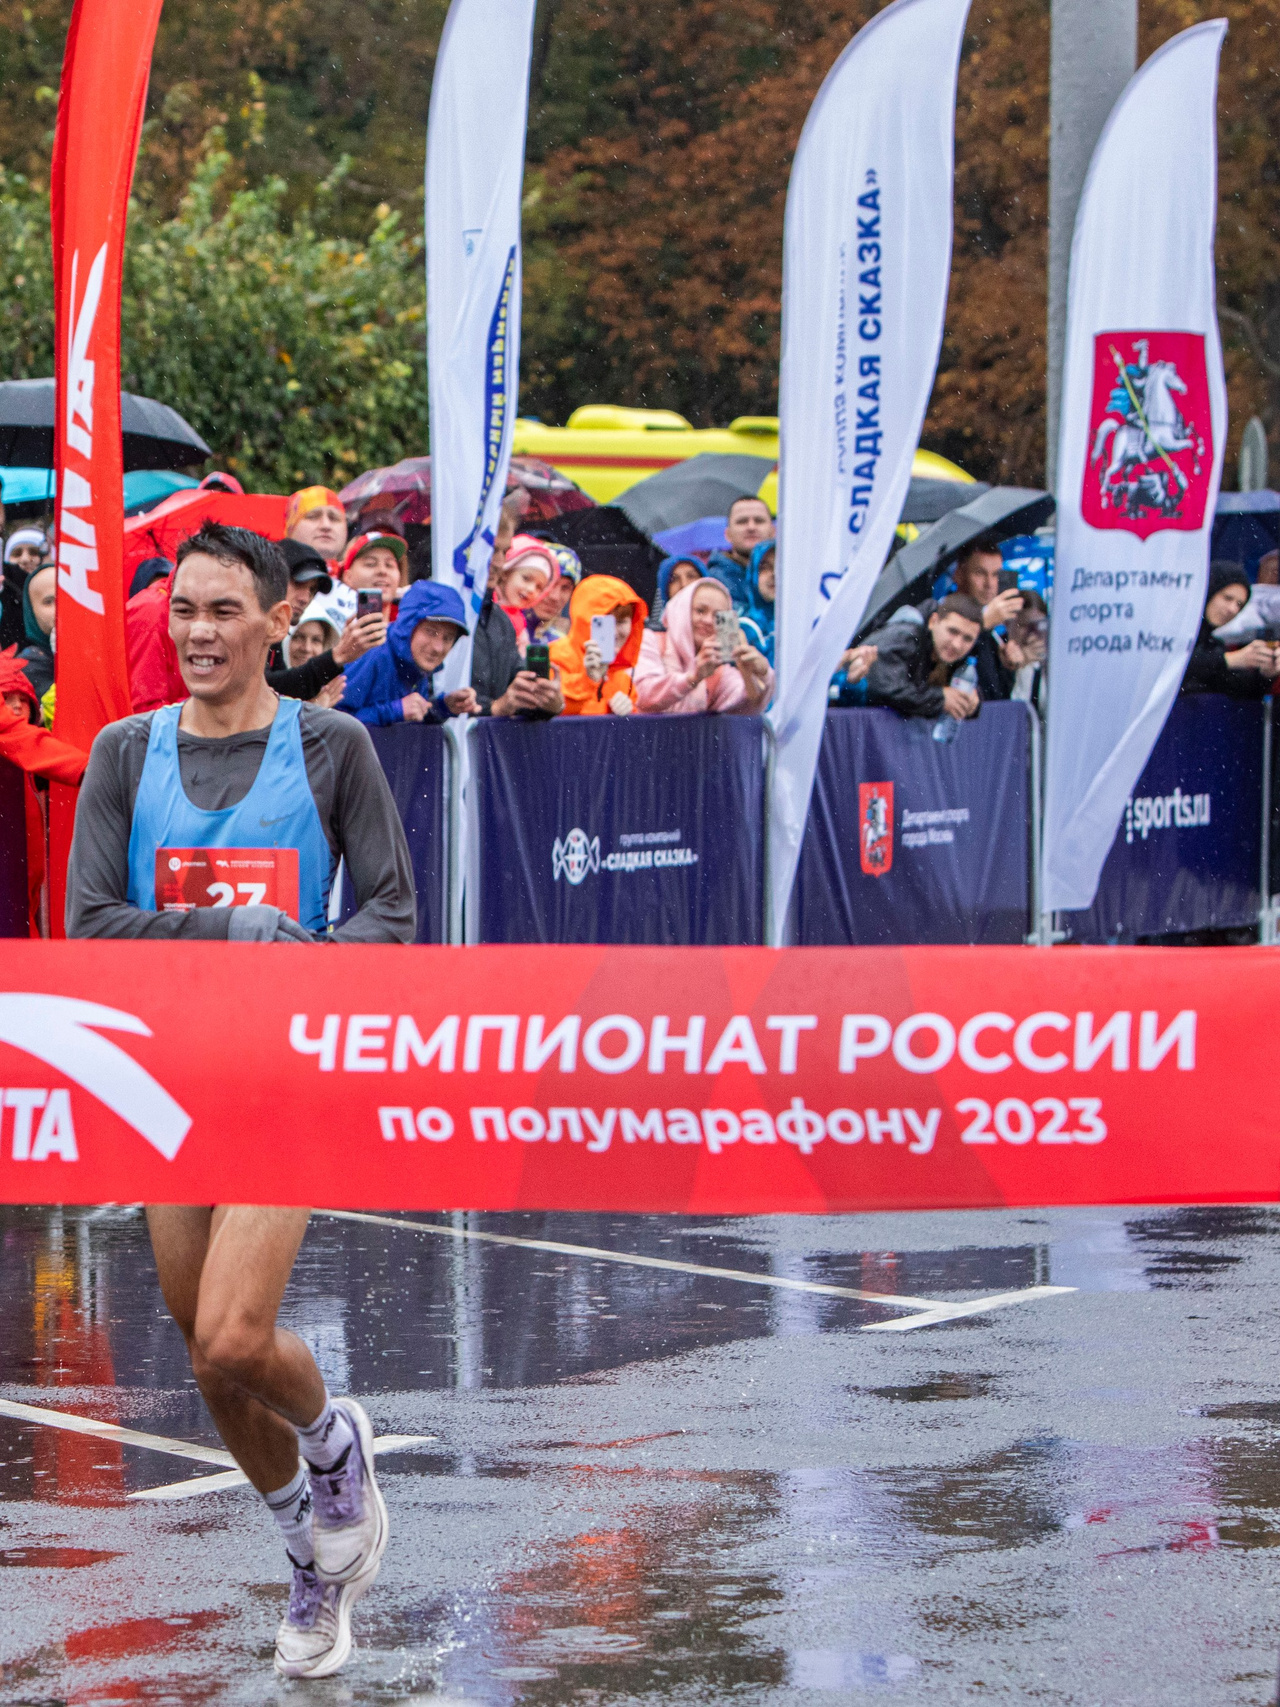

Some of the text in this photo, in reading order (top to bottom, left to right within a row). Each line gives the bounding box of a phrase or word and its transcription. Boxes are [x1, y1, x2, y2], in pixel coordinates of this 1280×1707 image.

[849, 168, 883, 537] СЛАДКАЯ СКАЗКА»
[1071, 568, 1193, 592] Департамент
[1133, 786, 1210, 840] sports.ru
[206, 881, 268, 909] 27
[288, 1010, 1197, 1074] ЧЕМПИОНАТ РОССИИ
[377, 1097, 1107, 1154] по полумарафону 2023
